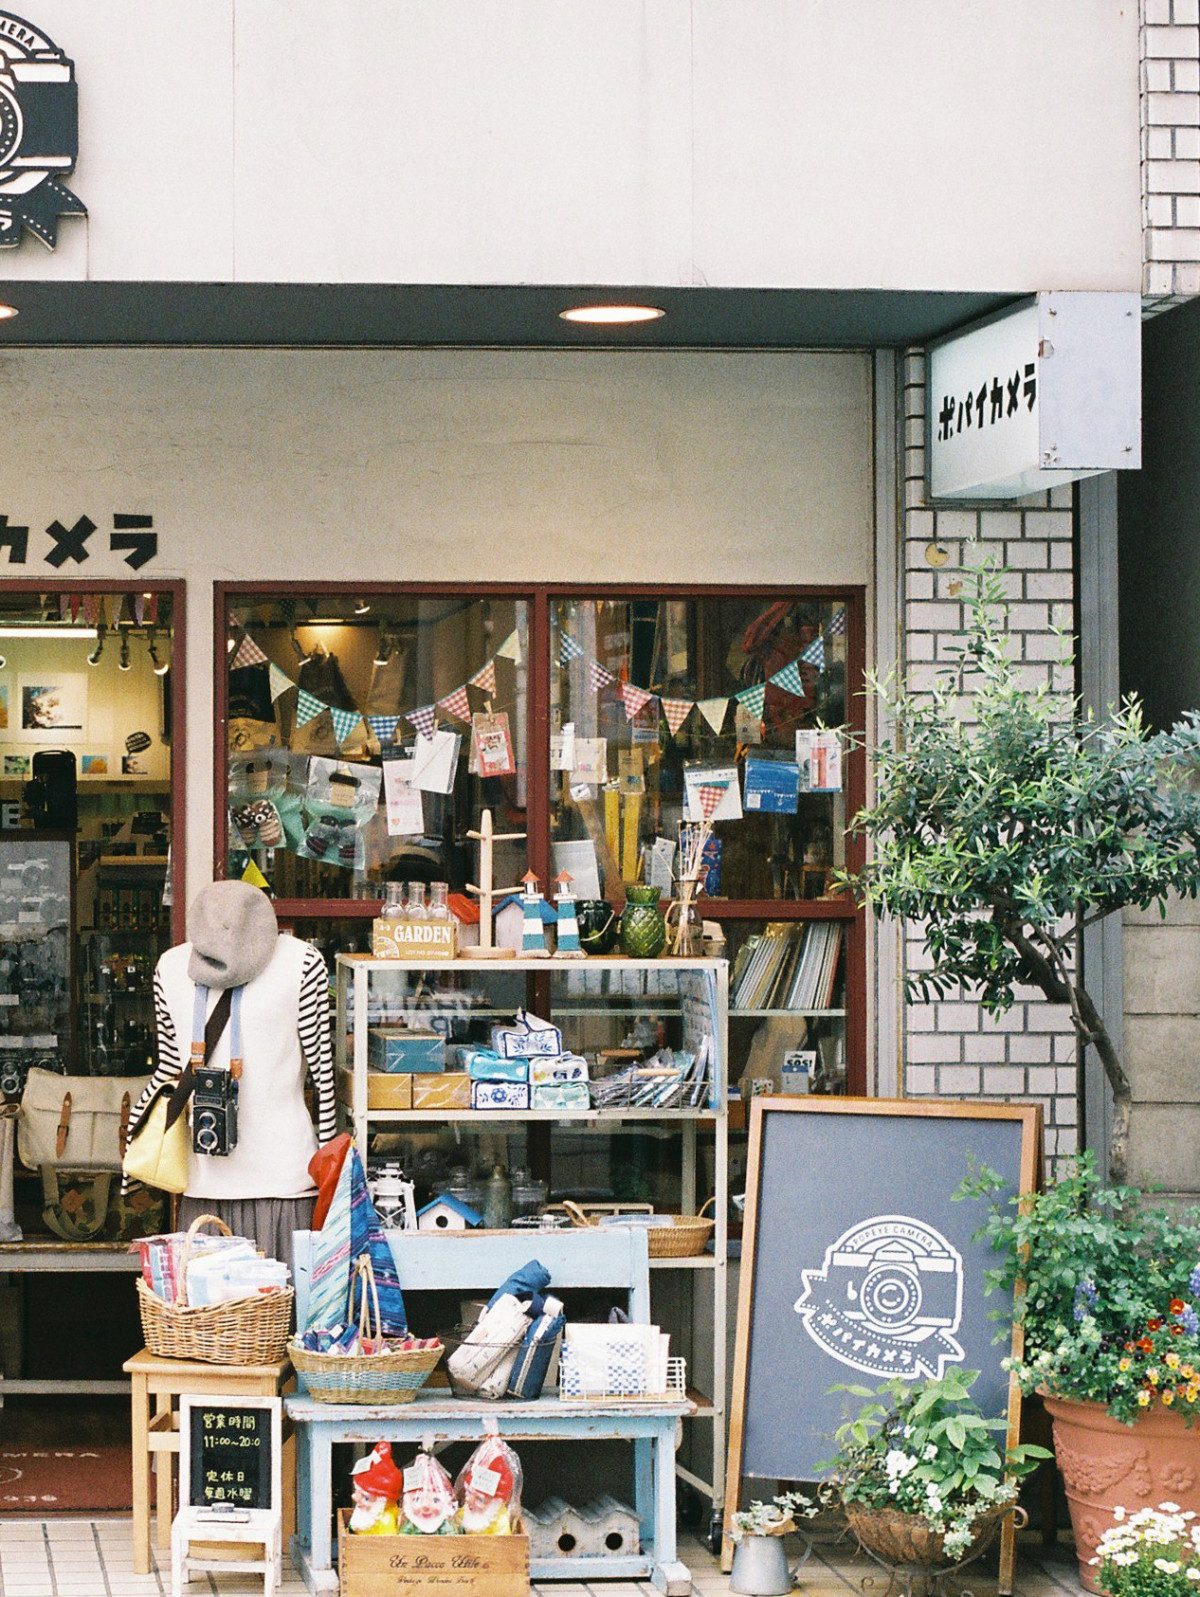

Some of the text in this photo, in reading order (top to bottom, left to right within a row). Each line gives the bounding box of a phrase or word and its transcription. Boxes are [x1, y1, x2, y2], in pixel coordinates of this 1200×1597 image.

[937, 362, 1037, 442] ポパイカメラ
[394, 925, 452, 944] GARDEN
[852, 1225, 933, 1248] POPEYE CAMERA
[816, 1312, 913, 1366] ポパイカメラ
[202, 1412, 256, 1430] 営業時間
[206, 1470, 245, 1482] 定休日
[204, 1486, 252, 1500] 毎週水曜
